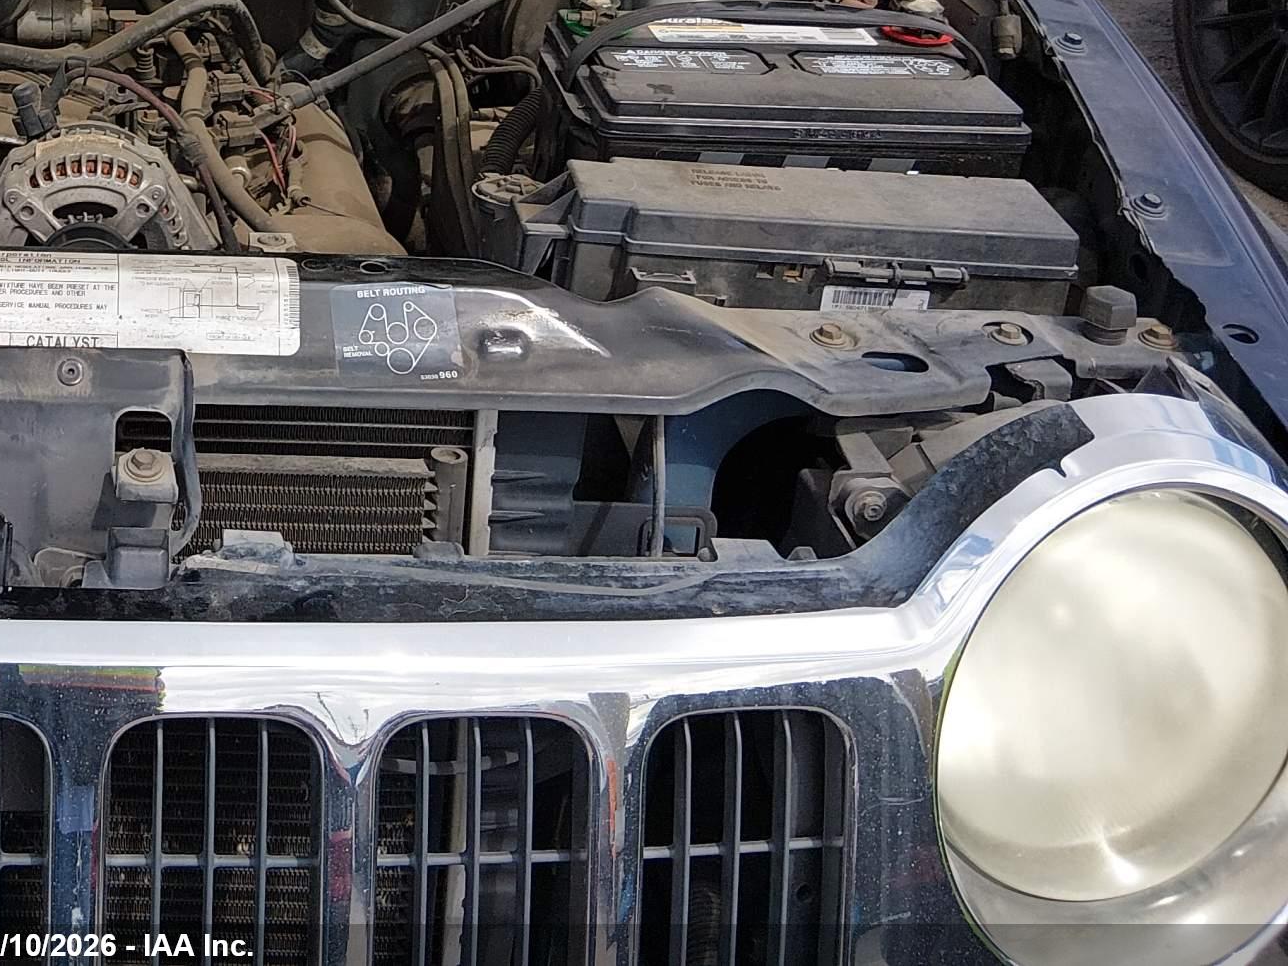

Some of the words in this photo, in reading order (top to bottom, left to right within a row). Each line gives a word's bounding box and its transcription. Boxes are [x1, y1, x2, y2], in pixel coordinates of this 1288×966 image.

[356, 289, 381, 298] BELT
[382, 286, 426, 297] ROUTING
[343, 350, 374, 358] REMOVAL
